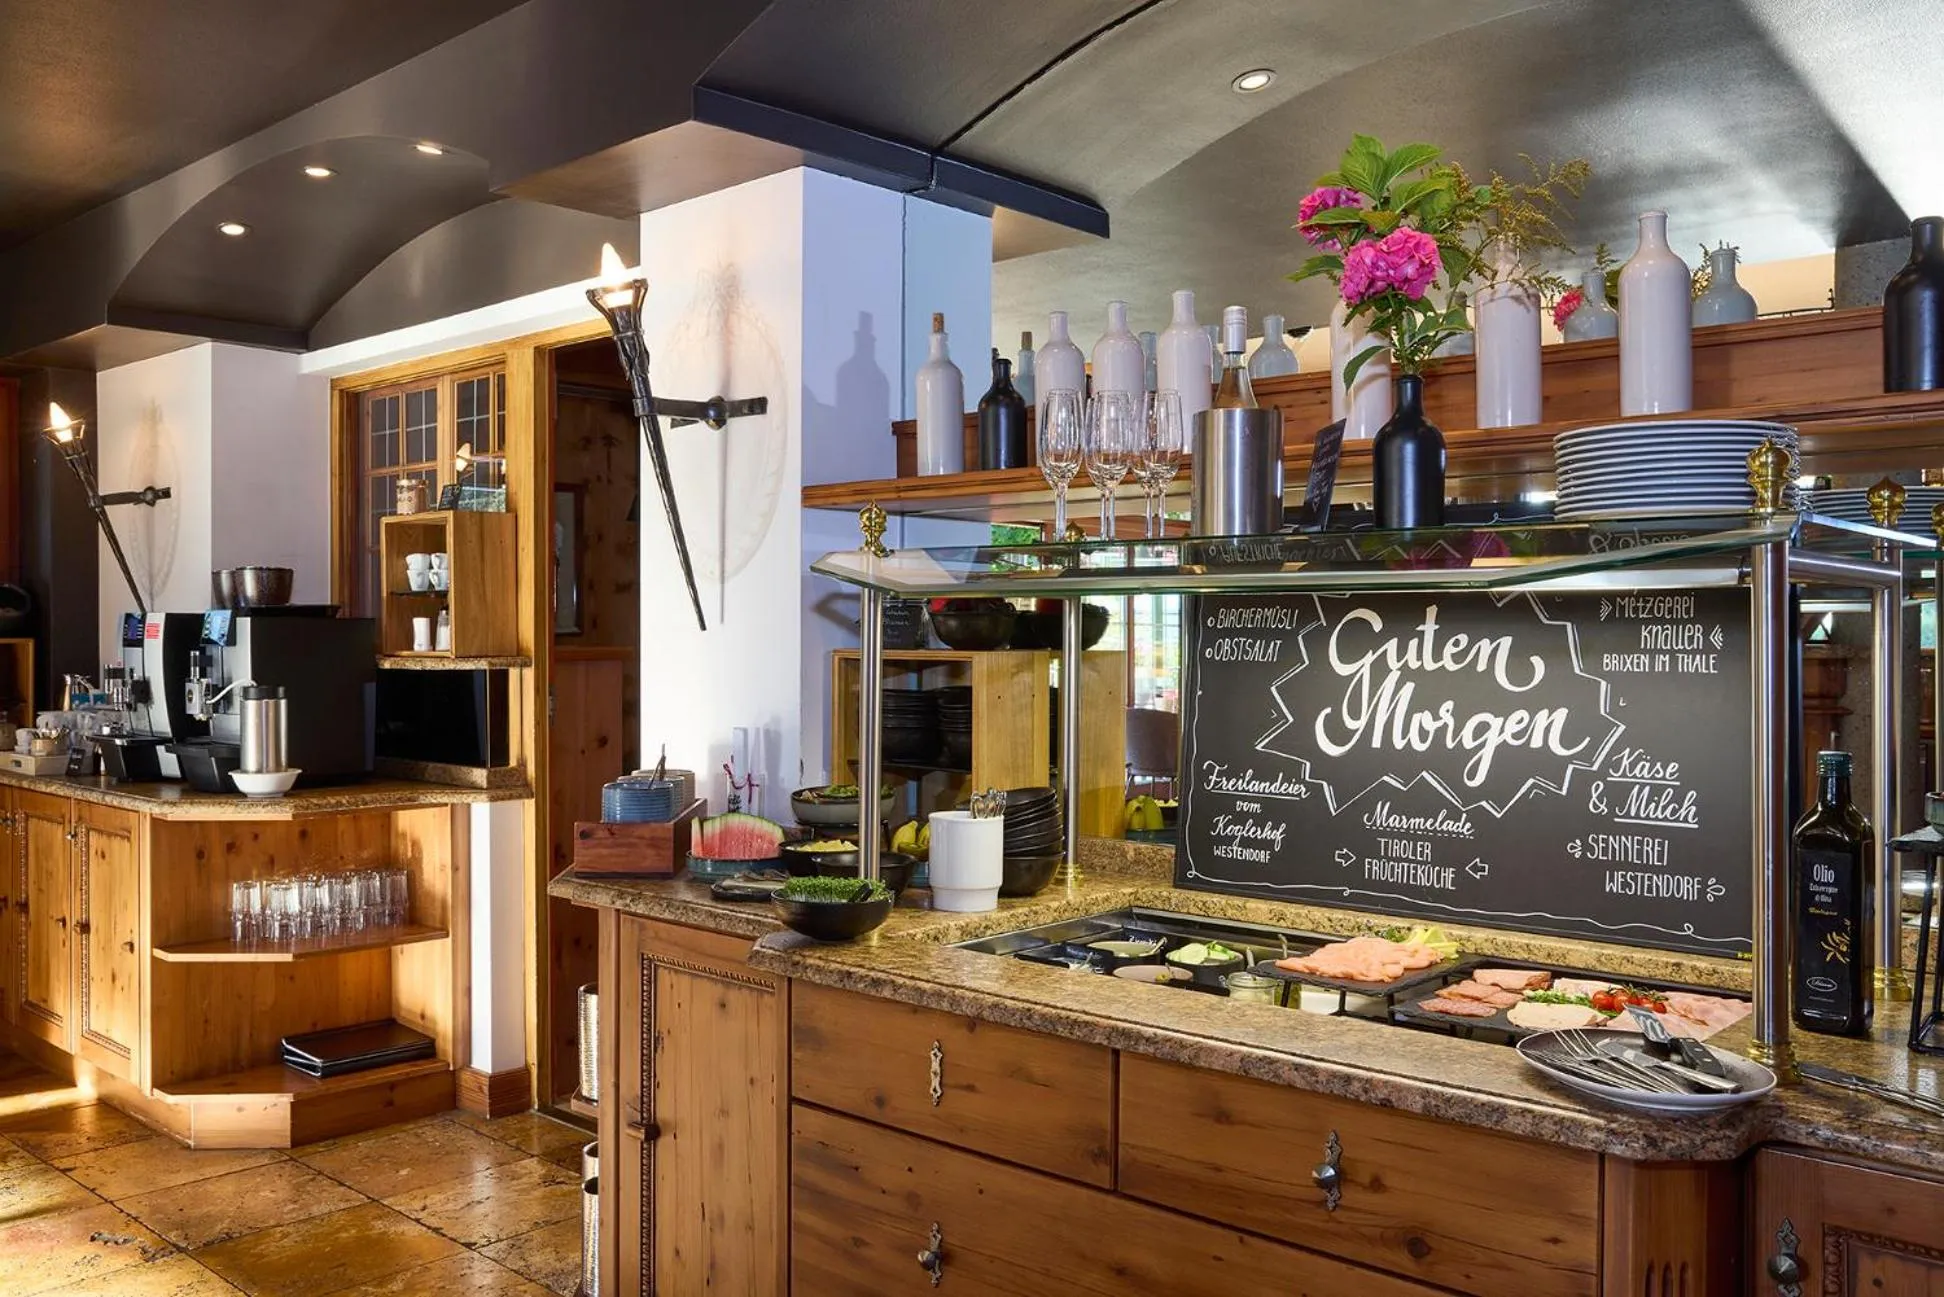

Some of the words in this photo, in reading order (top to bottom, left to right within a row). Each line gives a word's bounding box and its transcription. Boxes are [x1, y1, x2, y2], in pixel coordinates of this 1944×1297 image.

[1216, 606, 1299, 630] BIRCHERMÜSLI
[1213, 638, 1283, 662] OBSTSALAT
[1602, 653, 1650, 672] BRIXEN
[1654, 653, 1670, 673] IM
[1676, 653, 1719, 674] THALE
[1328, 603, 1546, 730] Guten
[1314, 668, 1591, 788] Morgen
[1202, 760, 1311, 799] Freilandeier
[1608, 747, 1680, 780] Käse
[1235, 800, 1262, 813] vom
[1363, 800, 1476, 835] Marmelade
[1588, 780, 1608, 816] &
[1615, 784, 1699, 824] Milch
[1210, 814, 1287, 852] Koglerhof
[1213, 845, 1272, 864] WESTENDORF
[1376, 837, 1432, 862] TIROLER
[1586, 833, 1669, 866] SENNEREI
[1605, 870, 1702, 901] WESTENDORF
[1813, 863, 1835, 883] Olio
